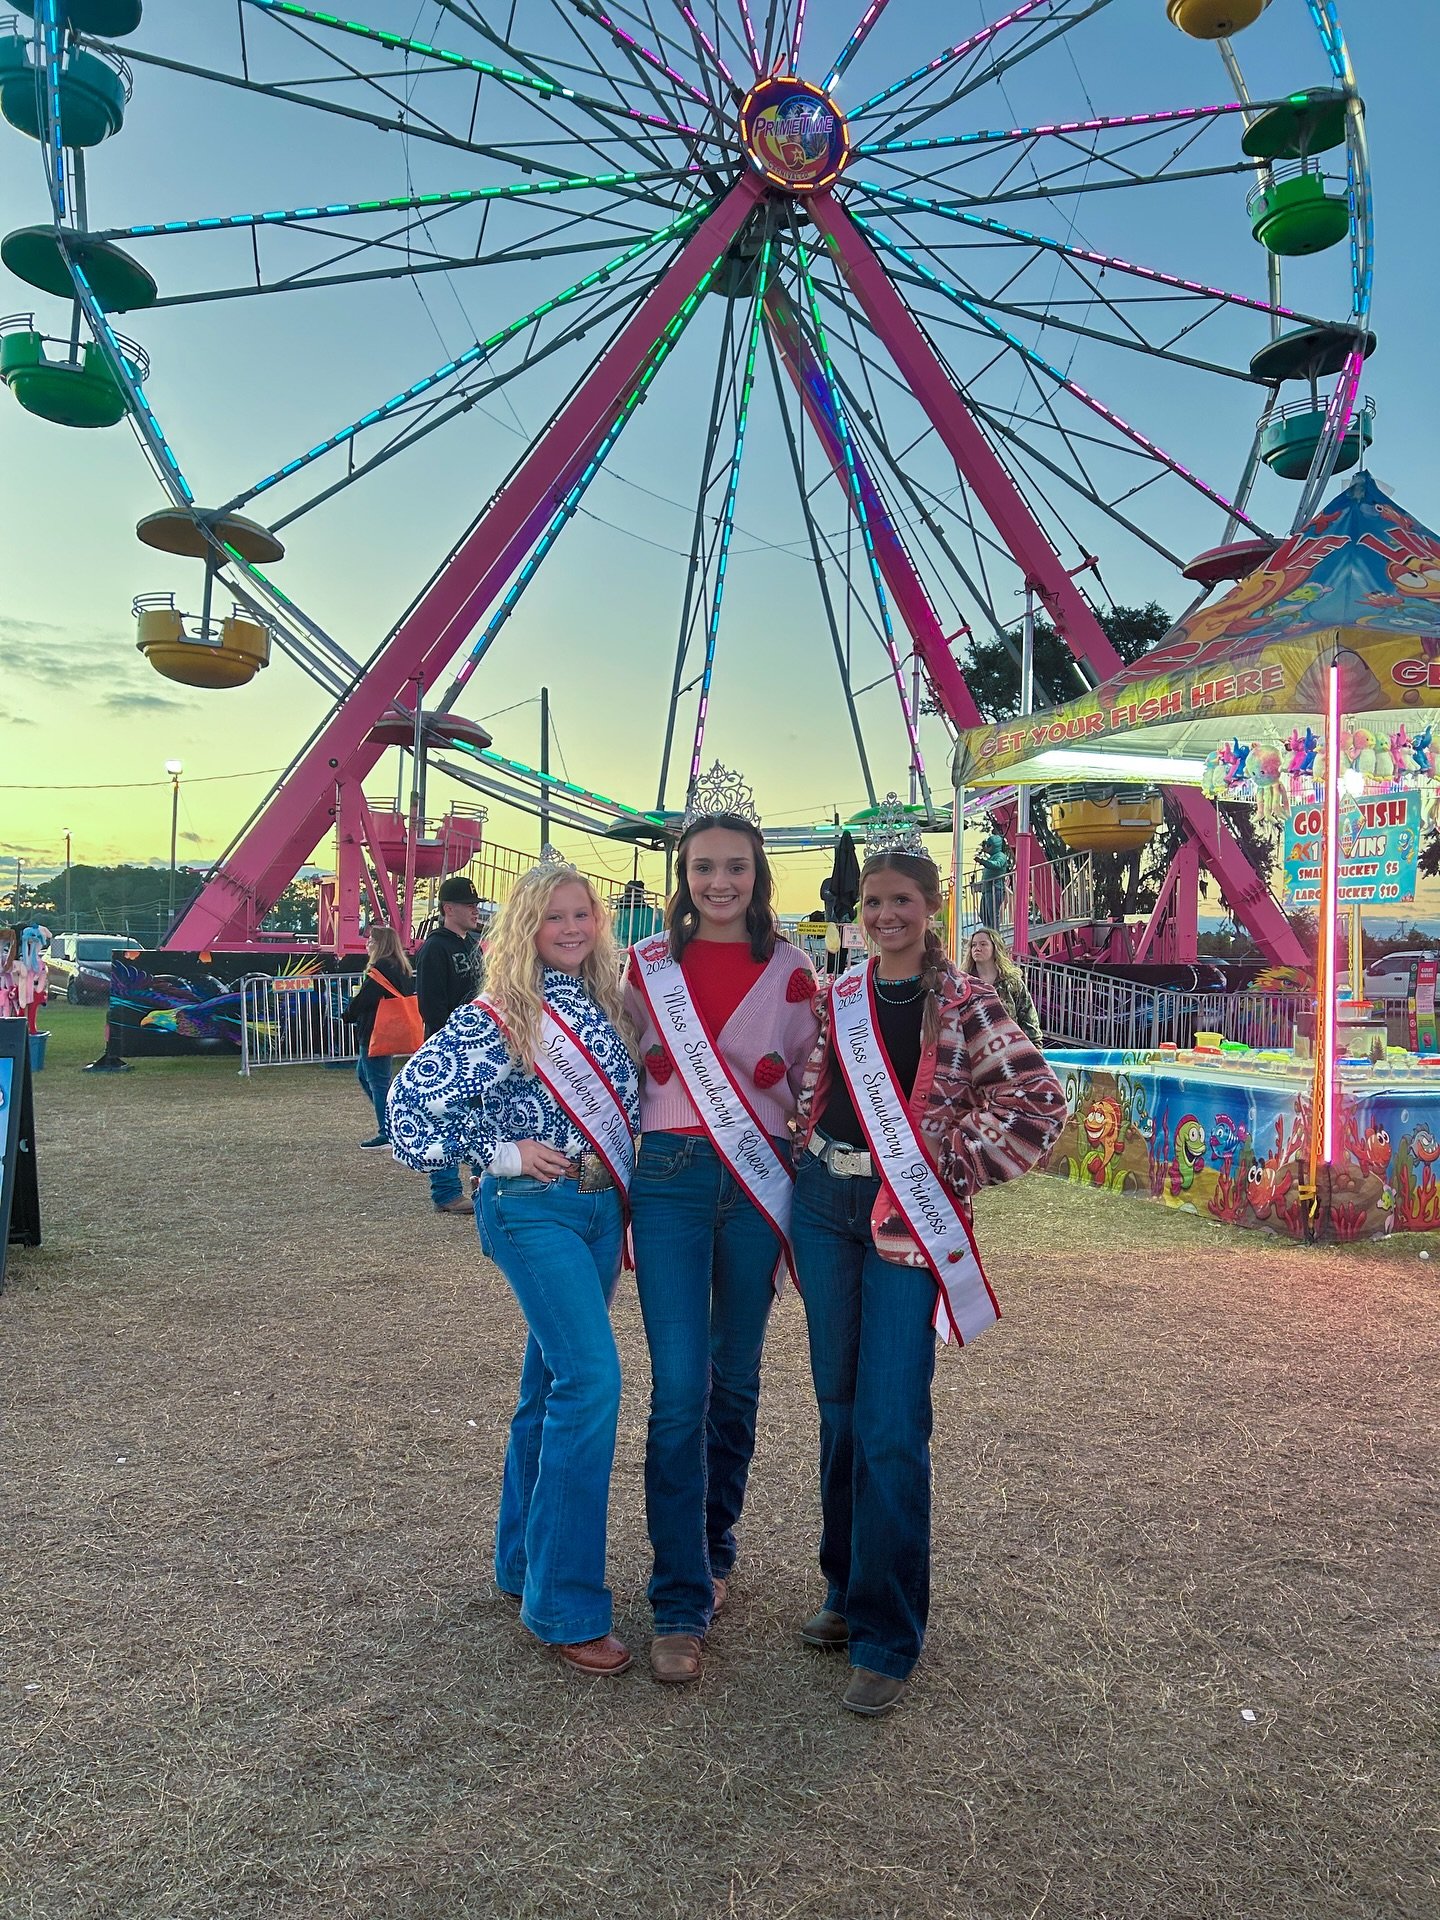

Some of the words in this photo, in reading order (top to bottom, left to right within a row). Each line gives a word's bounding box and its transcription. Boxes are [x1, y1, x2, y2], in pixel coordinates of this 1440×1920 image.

[979, 731, 1026, 759] GET
[1031, 712, 1105, 747] YOUR
[1110, 689, 1183, 729] FISH
[1190, 664, 1286, 710] HERE
[1385, 862, 1399, 875] $5
[1295, 888, 1322, 901] LARG
[1338, 885, 1375, 899] UCKET
[1380, 884, 1399, 899] $10
[646, 955, 673, 976] 2025
[275, 978, 312, 991] EXIT
[838, 990, 863, 1011] 2025
[540, 1034, 602, 1118] Strawberry
[663, 984, 687, 1033] Miss
[683, 1040, 736, 1129] Strawberry
[736, 1130, 771, 1181] Queen
[847, 1018, 869, 1064] Miss
[862, 1071, 904, 1160] Strawberry
[901, 1163, 948, 1237] Princess
